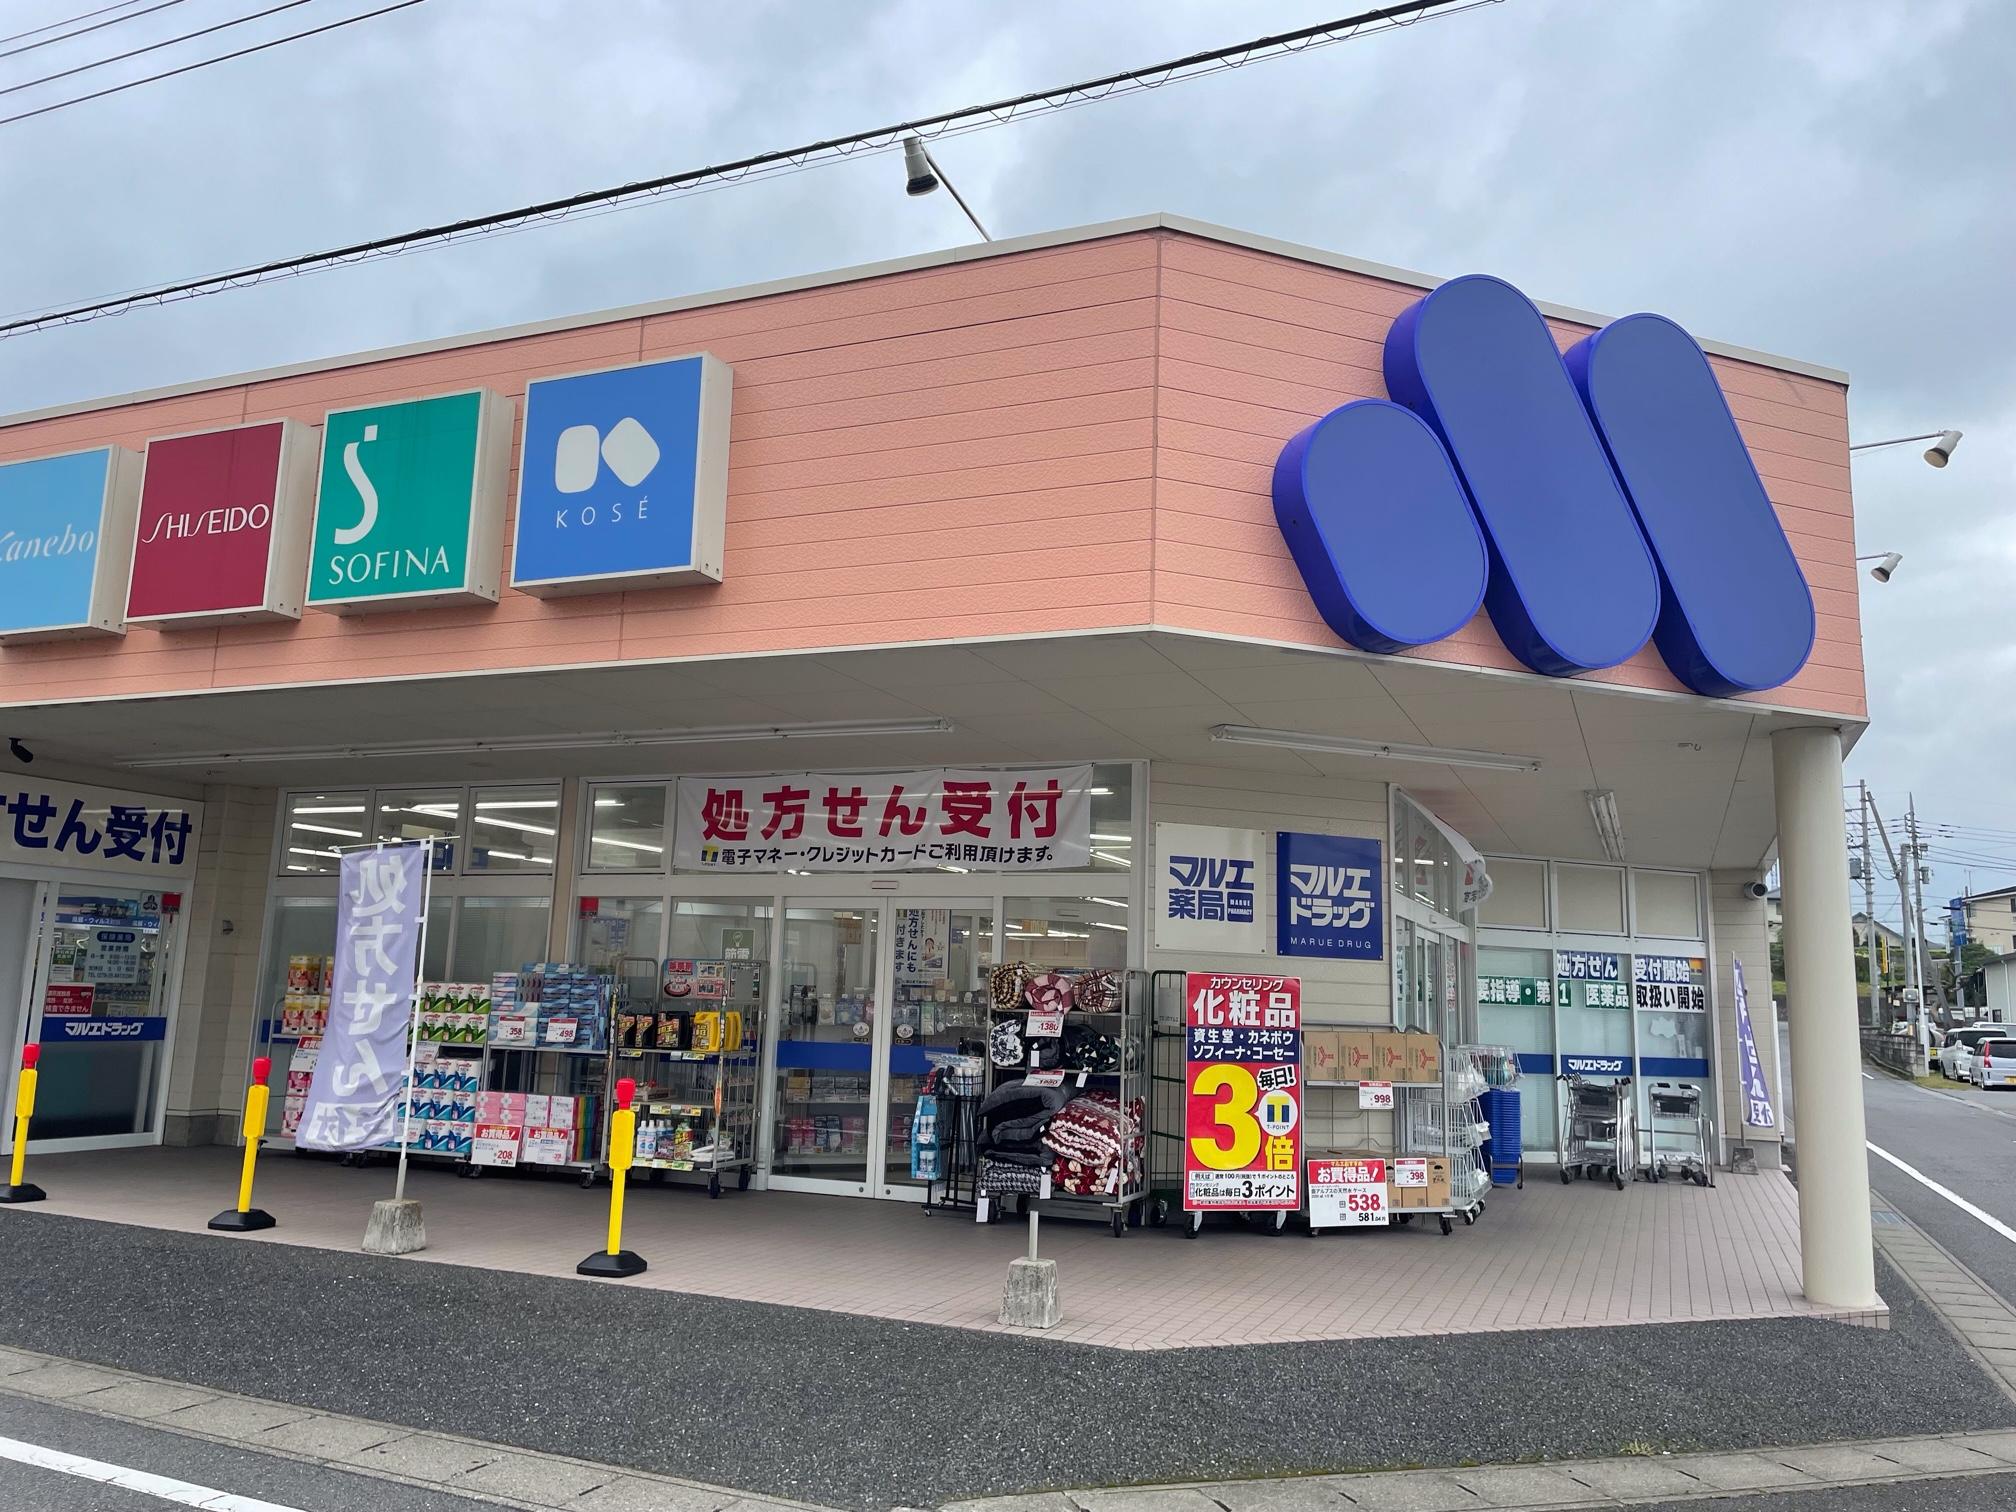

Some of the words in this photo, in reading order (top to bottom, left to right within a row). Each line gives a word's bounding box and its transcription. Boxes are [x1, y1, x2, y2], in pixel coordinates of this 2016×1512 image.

[142, 503, 271, 545] SHISEIDO
[555, 495, 650, 530] KOSÉ
[328, 545, 451, 586] SOFINA
[701, 779, 1063, 841] 処方せん受付
[0, 792, 193, 865] せん受付
[721, 843, 1053, 866] 電子マネー・クレジットカードご利用頂けます。
[1169, 855, 1254, 891] マルエ
[1290, 863, 1371, 898] マルエ
[1168, 888, 1225, 922] 薬局
[1227, 908, 1252, 916] PHARMACY
[1230, 899, 1251, 907] MARUE
[1290, 896, 1375, 929] ドラッグ
[1290, 936, 1333, 947] MARUE
[1338, 939, 1372, 949] DRUG
[1556, 952, 1618, 979] 処方せん
[1635, 957, 1691, 983] 受付開始
[1210, 977, 1284, 992] カウンセリング
[1193, 989, 1296, 1028] 化粧品
[1585, 986, 1630, 1009] 医薬品
[1637, 984, 1704, 1010] 取扱い開始
[65, 1022, 144, 1036] マルエドラッグ
[509, 1027, 522, 1036] 358
[559, 1029, 574, 1038] 498
[1193, 1028, 1294, 1045] 資生堂・カネボウ
[1193, 1045, 1295, 1060] ソフィーナ・コーセー
[1567, 1058, 1623, 1072] マルエドラッグ
[1374, 1094, 1391, 1103] 998
[1190, 1064, 1262, 1171] 3
[497, 1150, 513, 1160] 208
[1264, 1136, 1295, 1170] 倍
[1317, 1166, 1378, 1183] お買得品!
[1410, 1171, 1425, 1180] 398
